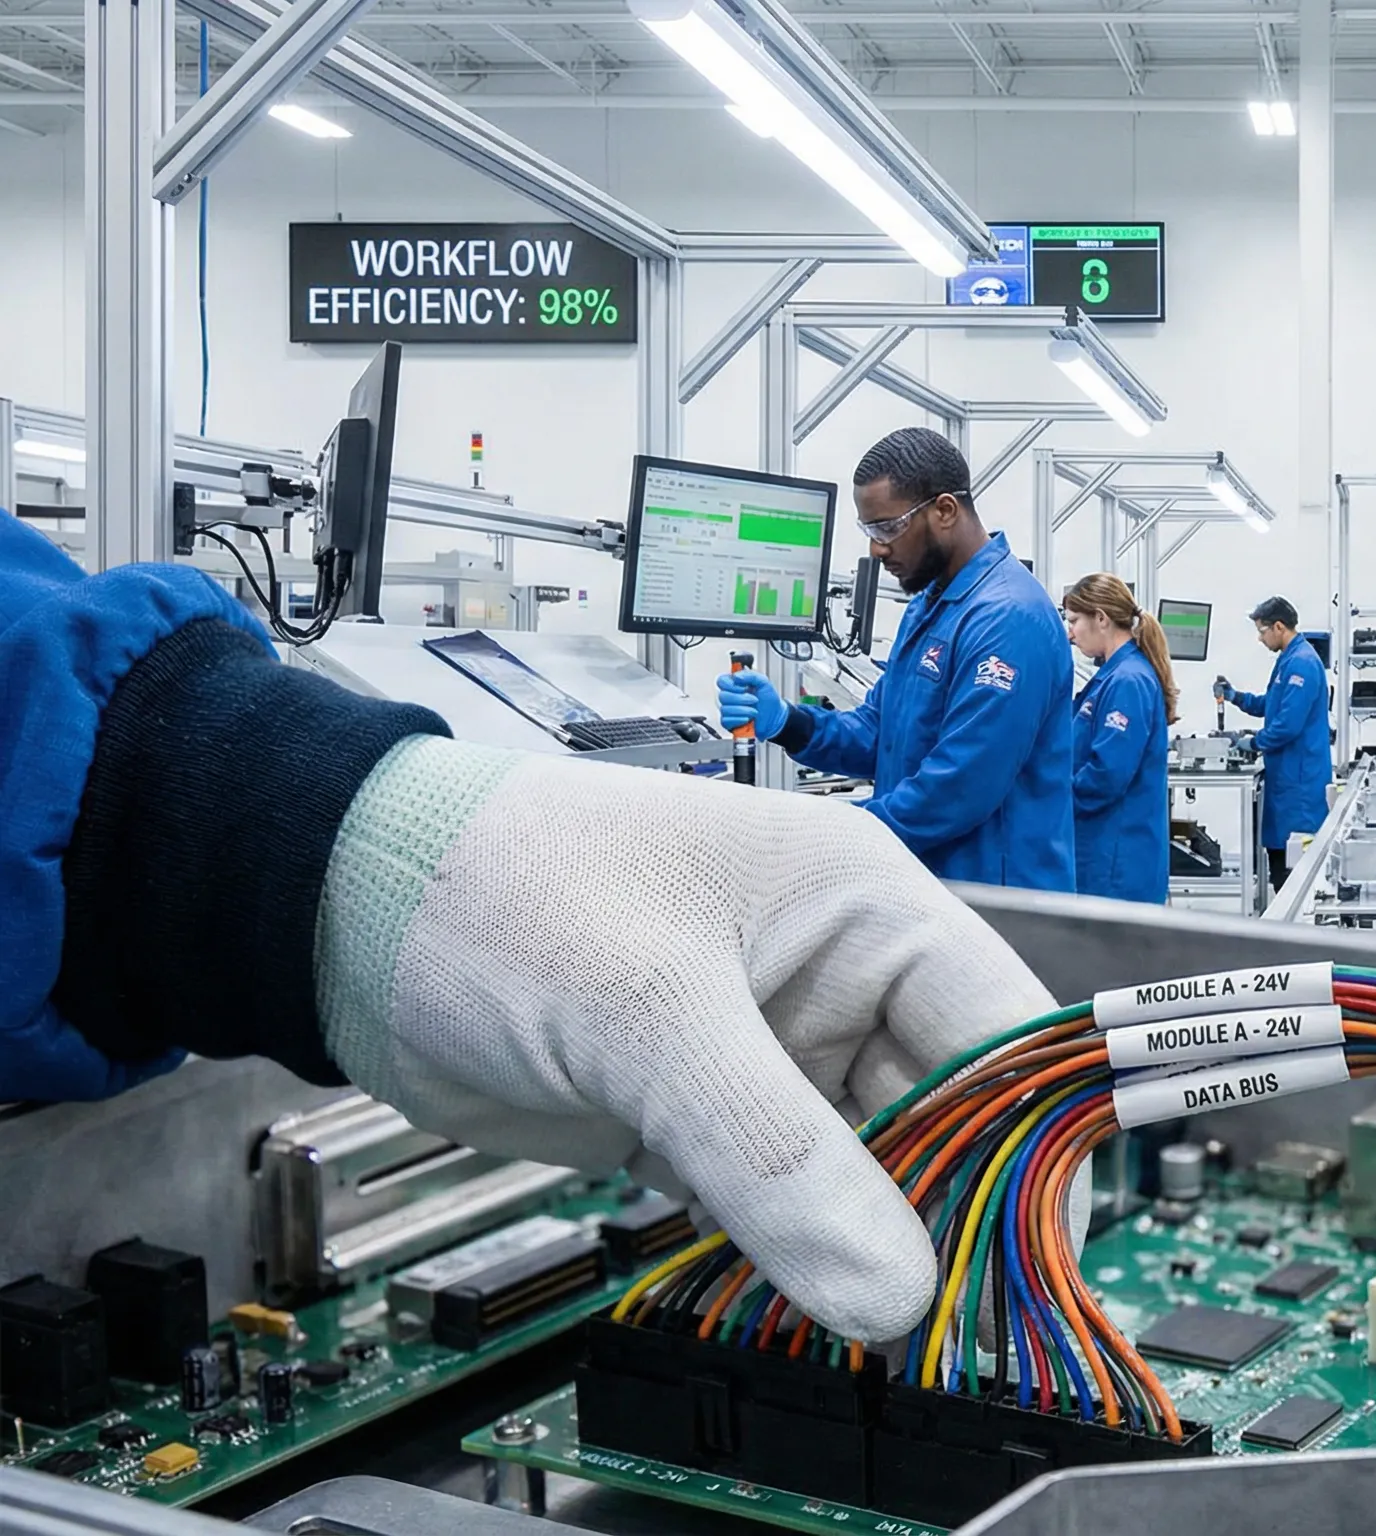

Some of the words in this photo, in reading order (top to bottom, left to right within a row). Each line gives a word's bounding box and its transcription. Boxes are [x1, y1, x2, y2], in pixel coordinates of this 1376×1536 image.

[350, 239, 573, 277] WORKFLOW
[308, 287, 526, 326] EFFICIENCY:
[538, 287, 619, 326] 98%
[1136, 979, 1217, 1006] MODULE
[1221, 977, 1235, 996] A
[1253, 972, 1290, 992] 24V
[1146, 1023, 1229, 1052] MODULE
[1234, 1021, 1249, 1042] A
[1265, 1015, 1302, 1038] 24V
[1183, 1082, 1237, 1109] DATA
[1239, 1072, 1279, 1098] BUS
